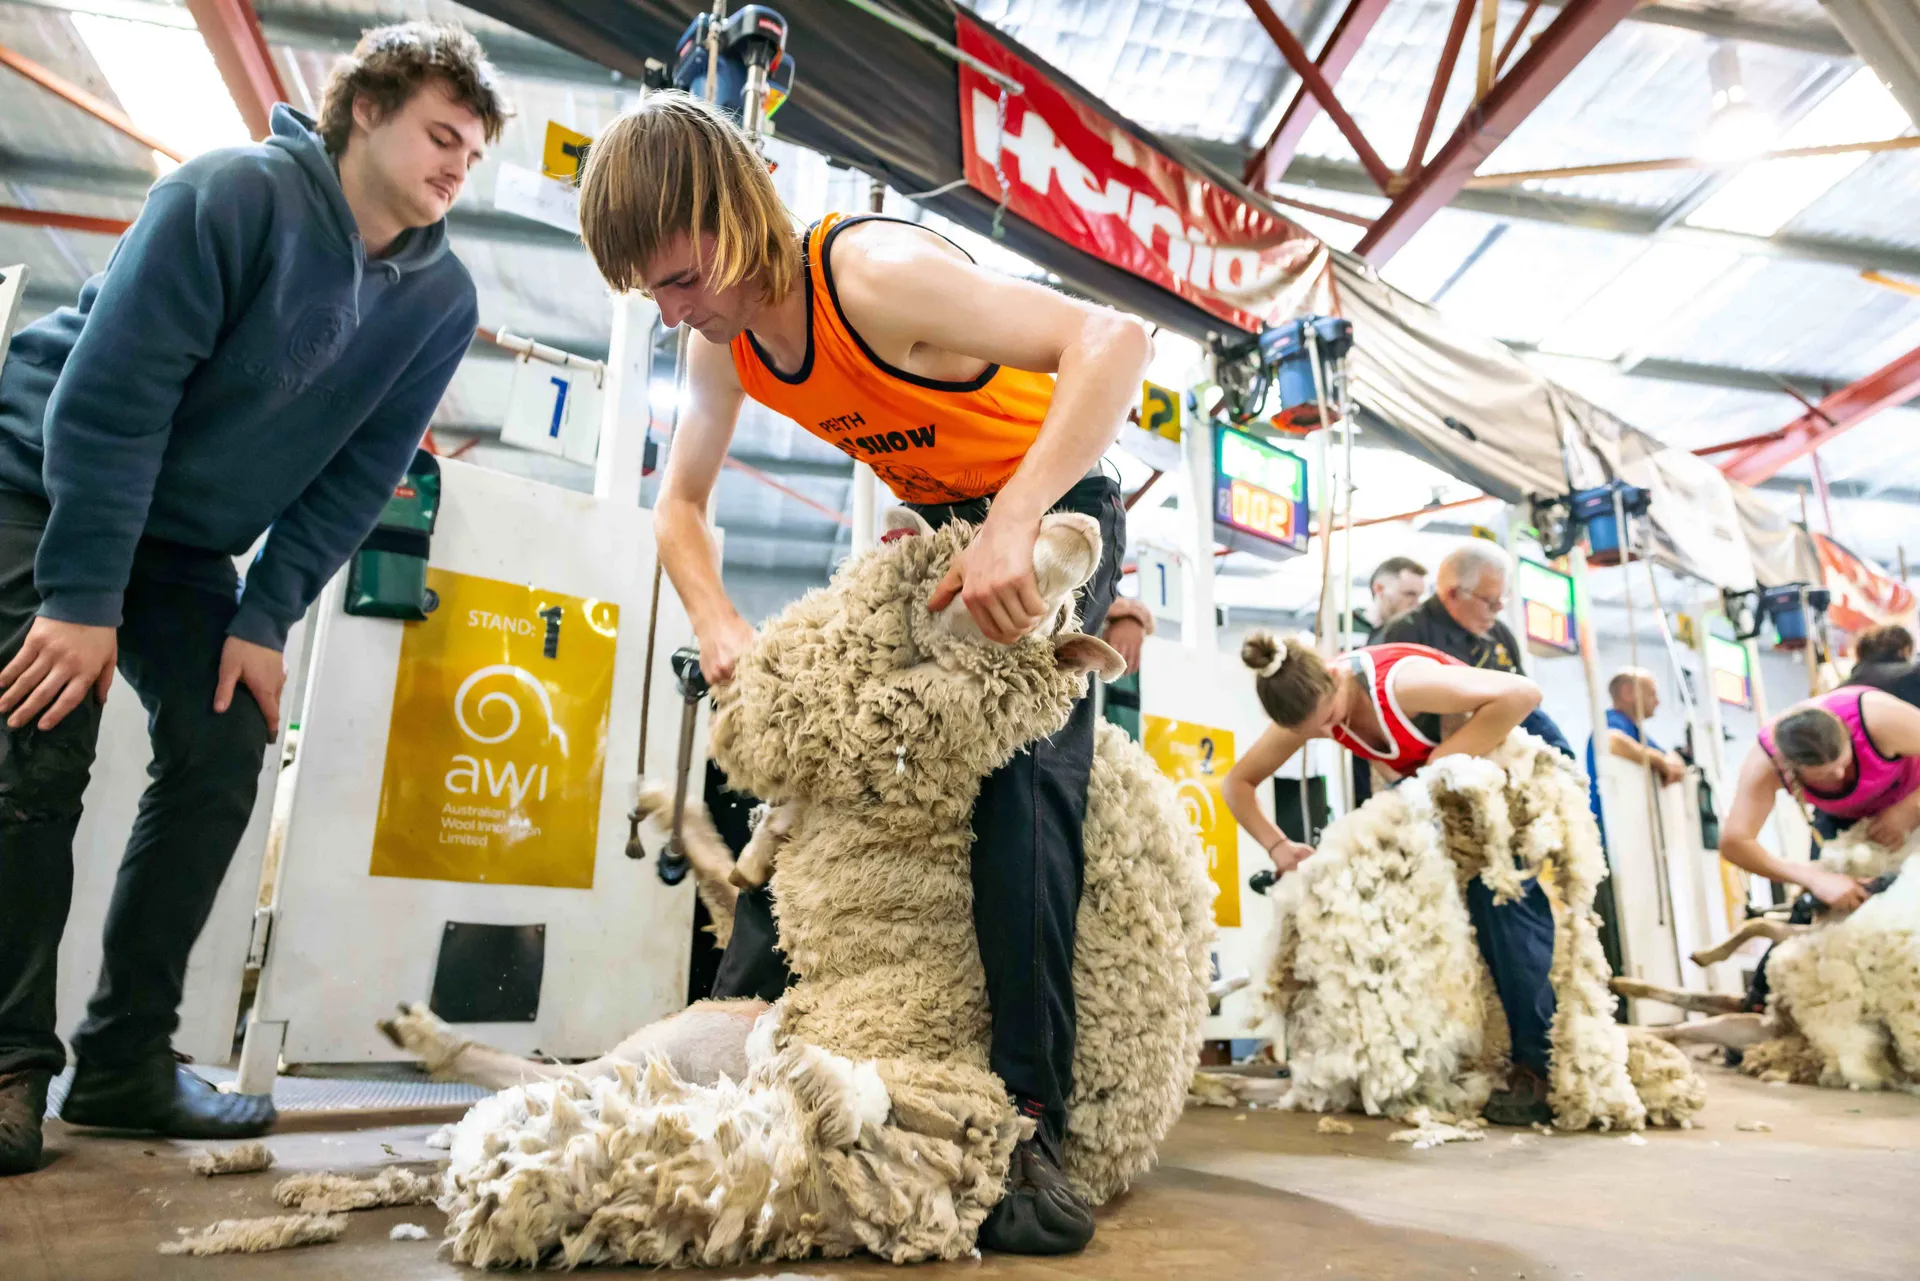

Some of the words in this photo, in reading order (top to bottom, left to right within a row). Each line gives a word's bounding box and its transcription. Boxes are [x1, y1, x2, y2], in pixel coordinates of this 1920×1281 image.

[550, 375, 568, 438] 1
[1149, 387, 1173, 428] 2
[855, 424, 936, 455] SHOW
[467, 609, 536, 638] STAND:
[539, 605, 562, 659] 1
[1201, 737, 1214, 775] 2
[441, 816, 475, 831] Wool
[477, 819, 542, 837] Innoon
[442, 802, 506, 819] Australian
[439, 831, 489, 848] Limited
